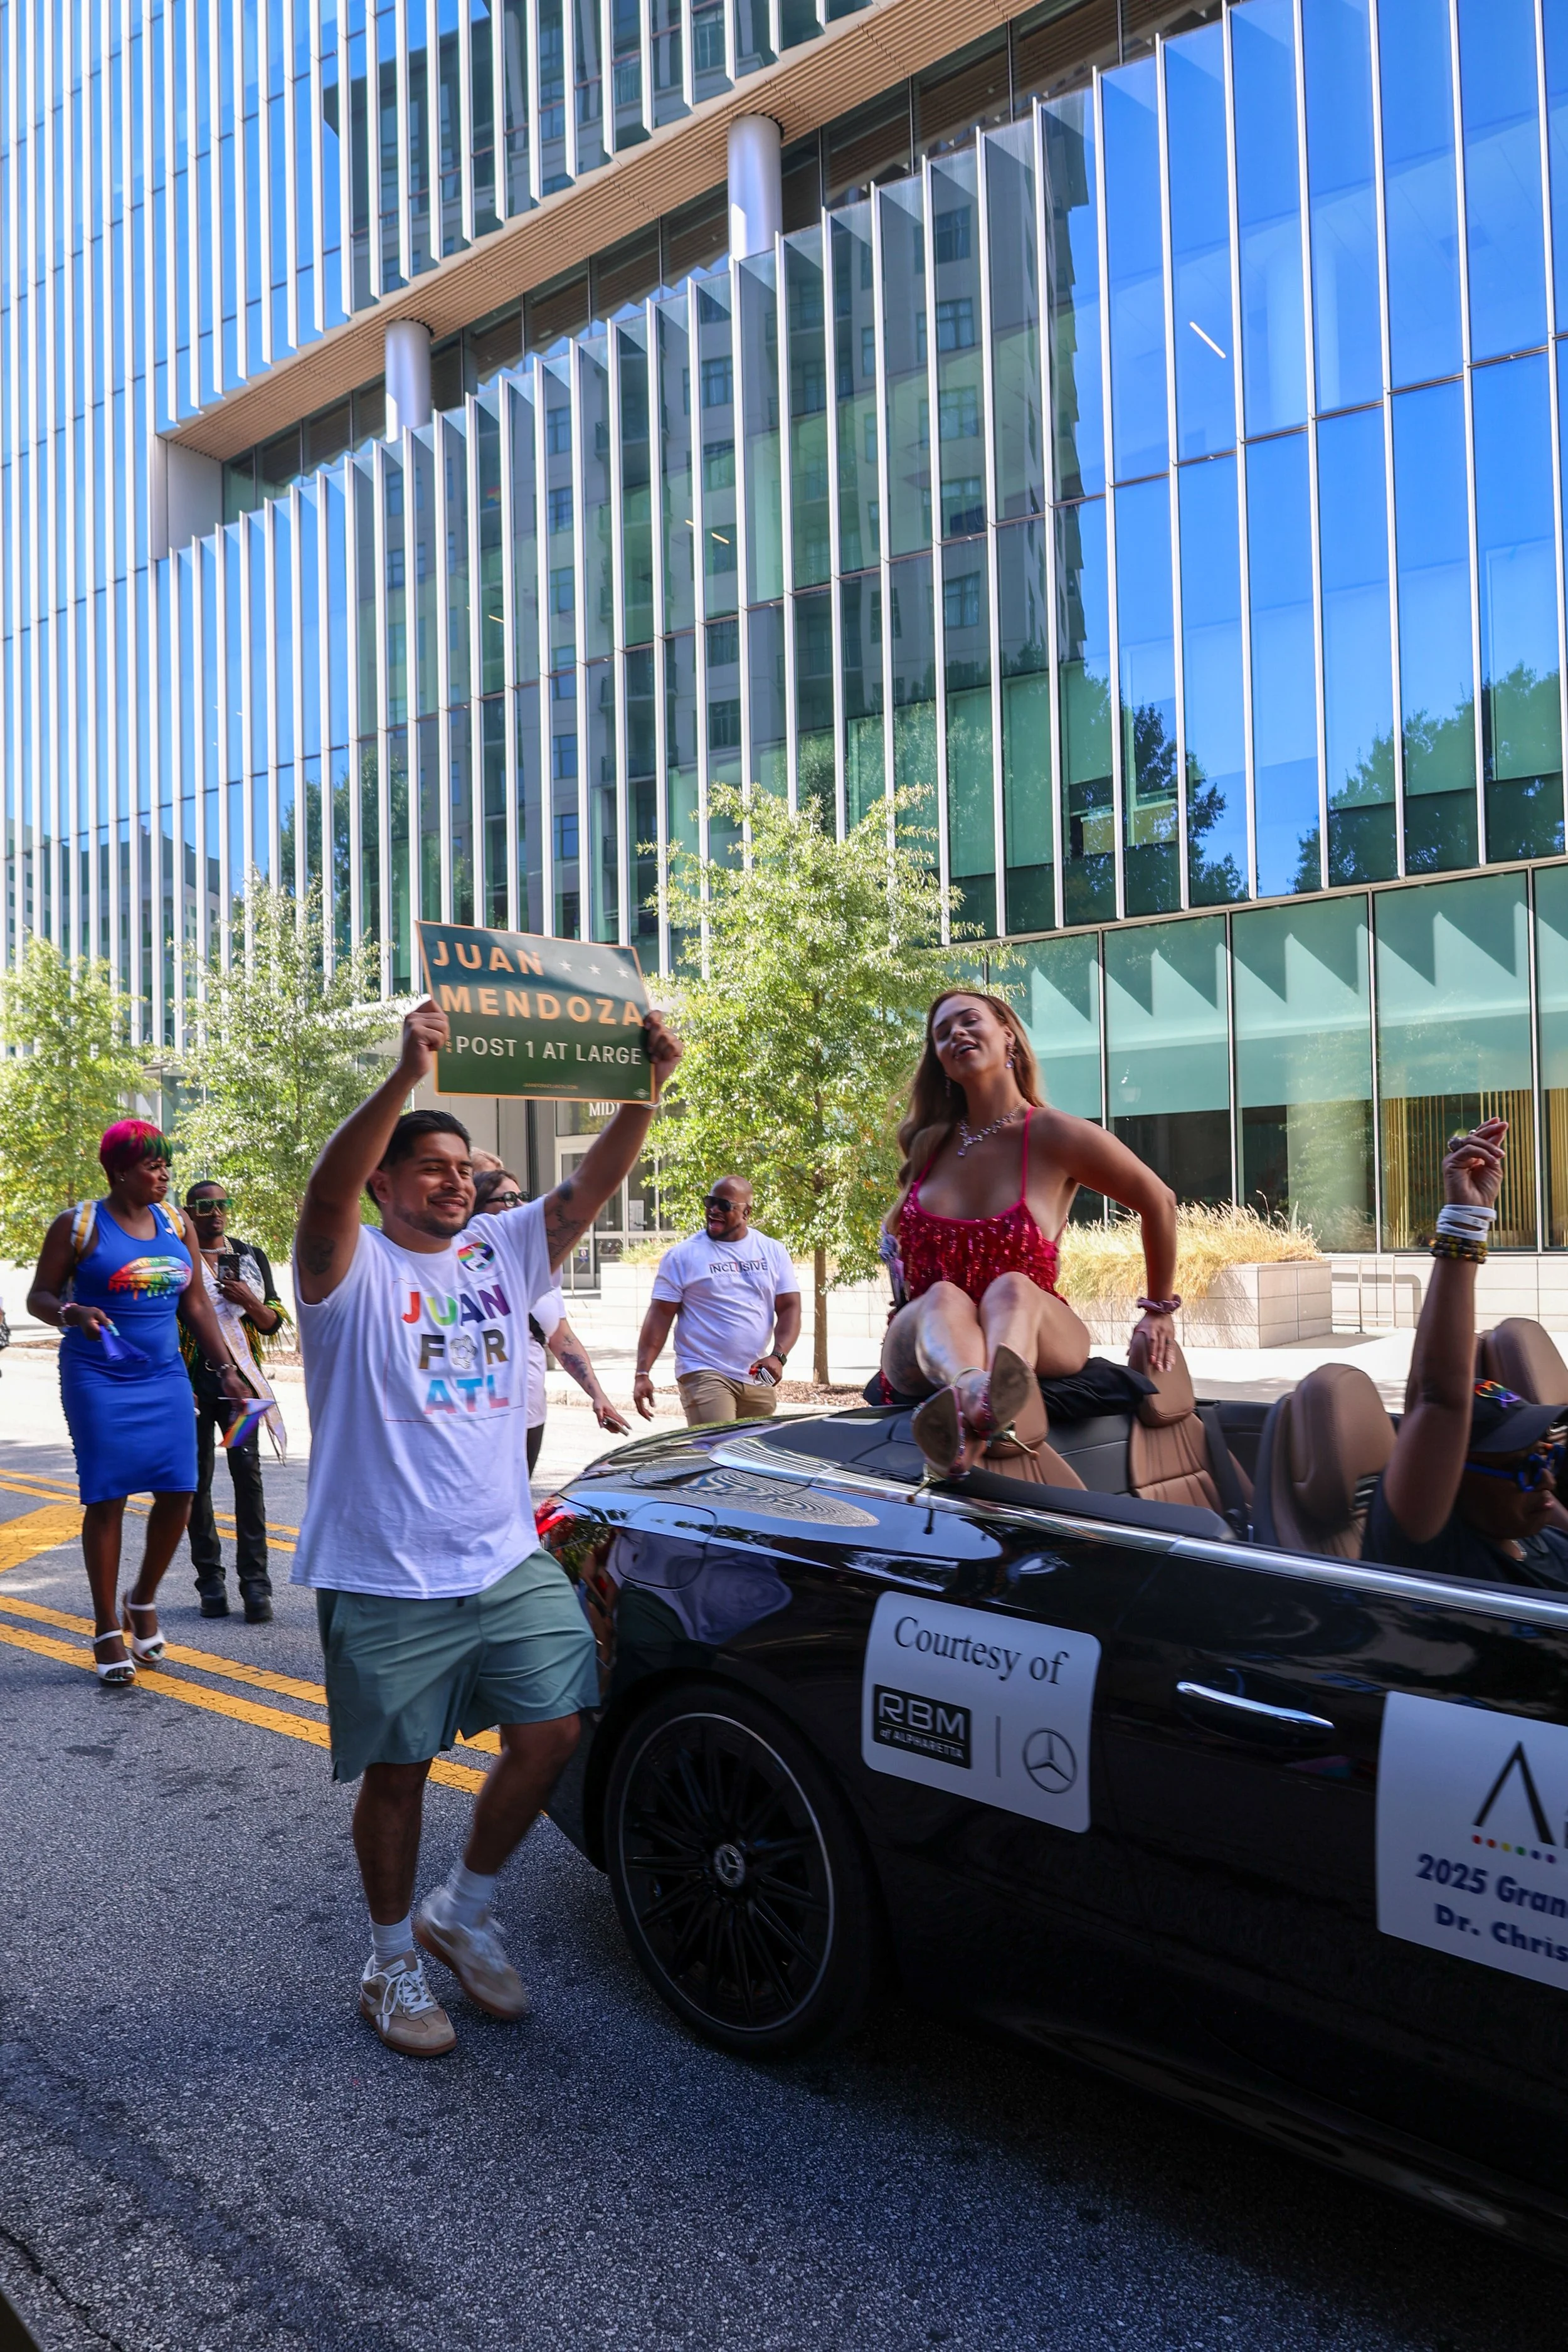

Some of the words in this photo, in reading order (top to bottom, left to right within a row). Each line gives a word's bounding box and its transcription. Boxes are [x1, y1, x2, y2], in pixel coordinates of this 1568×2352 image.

[433, 940, 545, 976] JUAN
[439, 985, 645, 1027] MENDOZA
[455, 1036, 517, 1057] POST
[525, 1041, 534, 1059] 1
[543, 1041, 569, 1061] AT
[576, 1044, 642, 1066] LARGE
[709, 1259, 768, 1274] INCLUSIVE
[401, 1284, 512, 1327] JUAN
[418, 1328, 509, 1370] FOR
[423, 1374, 510, 1415] ATL
[894, 1616, 1022, 1681] Courtesy
[1029, 1651, 1070, 1685] of
[879, 1692, 965, 1740] RBM
[1416, 1852, 1489, 1895] 2025
[1434, 1902, 1481, 1936] Dr.
[1490, 1920, 1568, 1963] Chris
